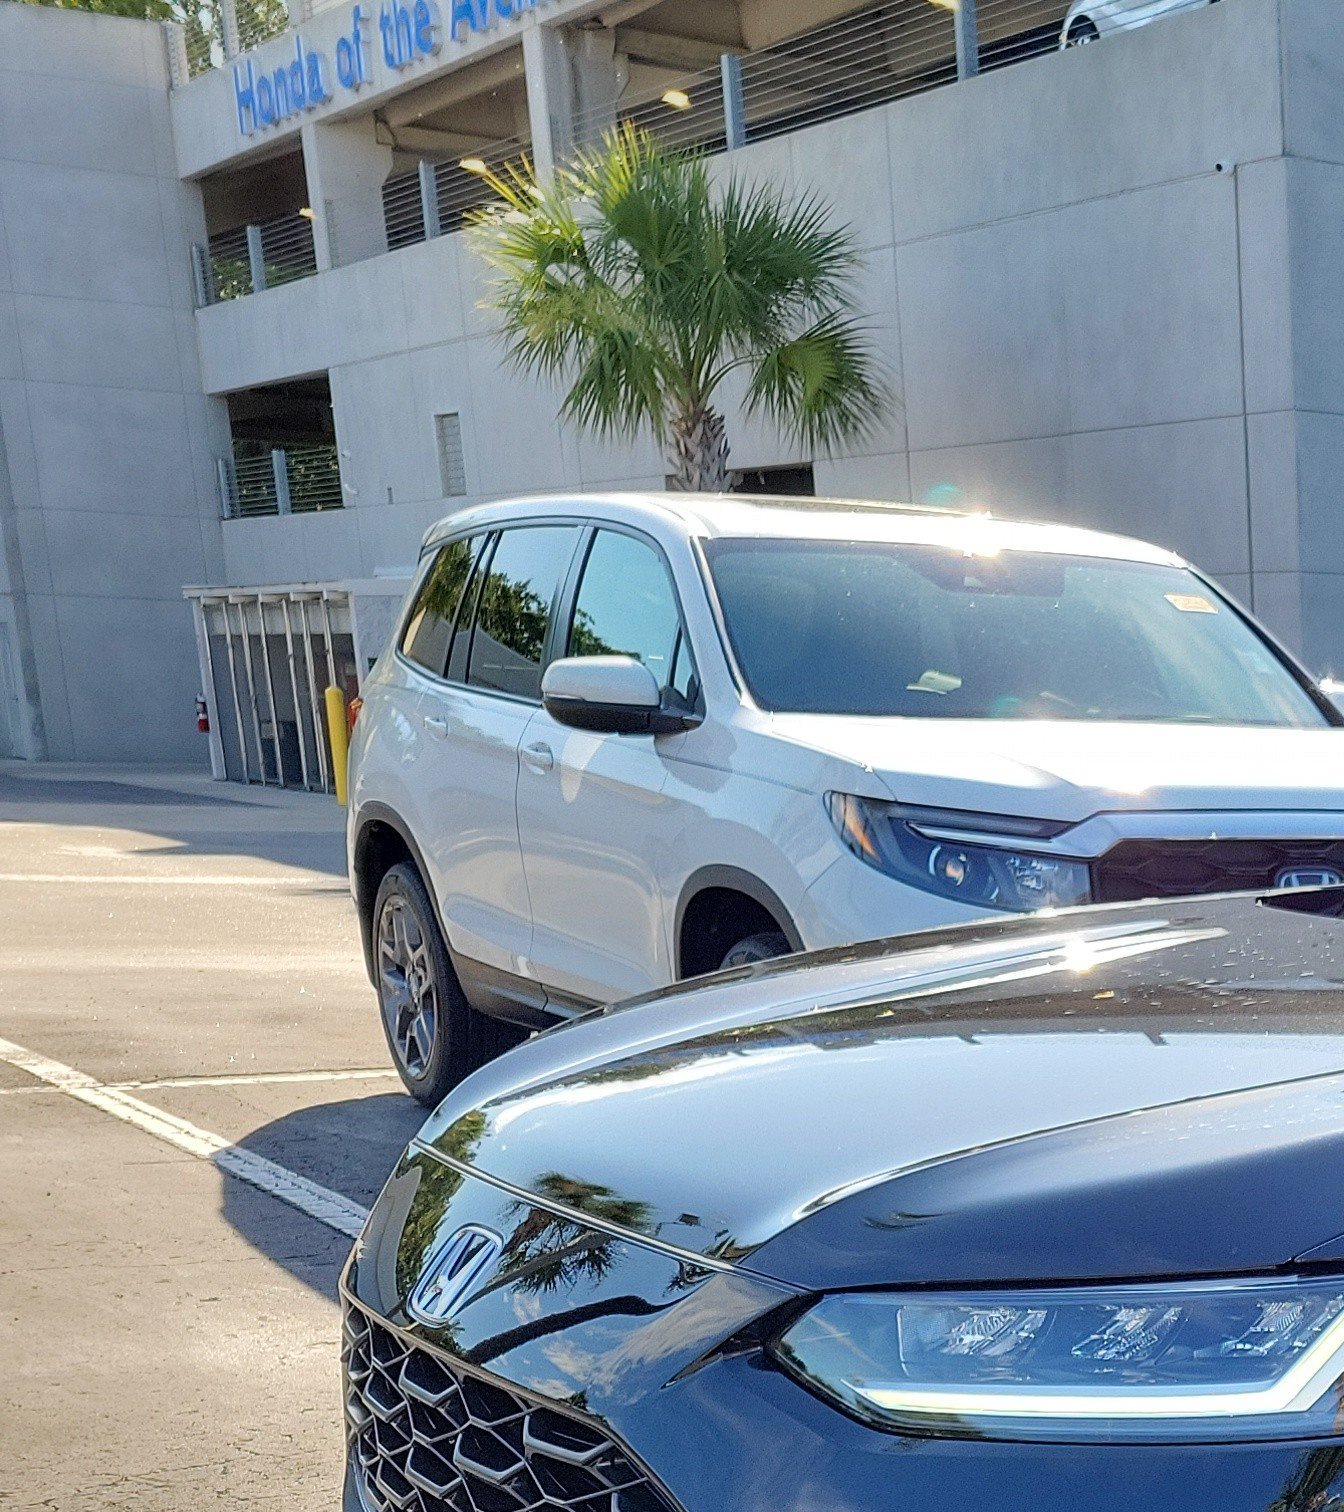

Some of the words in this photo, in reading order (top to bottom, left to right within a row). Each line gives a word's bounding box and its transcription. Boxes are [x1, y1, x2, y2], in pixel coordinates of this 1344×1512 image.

[233, 35, 325, 135] Honda
[336, 5, 364, 89] of
[379, 0, 433, 69] the
